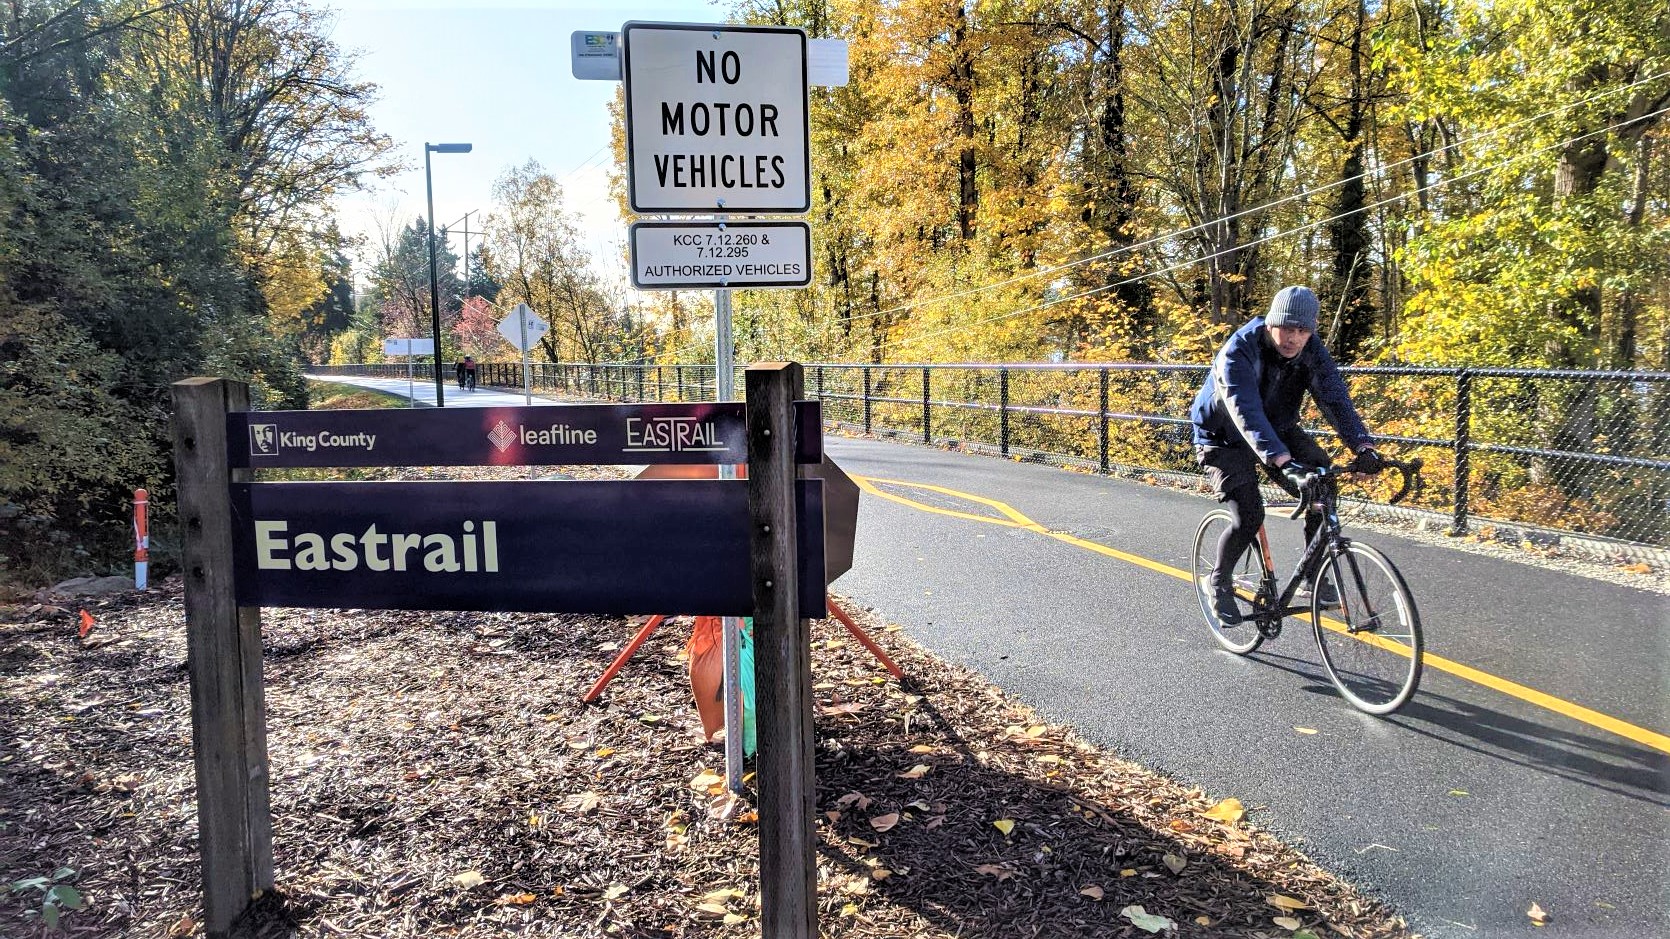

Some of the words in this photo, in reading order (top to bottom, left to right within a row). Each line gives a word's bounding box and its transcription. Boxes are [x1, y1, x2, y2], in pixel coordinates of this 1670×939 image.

[696, 50, 741, 85] NO
[661, 102, 779, 136] MOTOR
[653, 154, 785, 188] VEHICLES
[673, 235, 703, 246] KCC
[706, 234, 758, 246] 7.12.260
[761, 234, 770, 245] &
[697, 246, 749, 258] 7.12.295
[644, 264, 733, 277] AUTHORIZED
[735, 263, 801, 276] VEHICLES
[280, 431, 317, 452] King
[318, 430, 376, 451] County
[519, 424, 598, 445] leafline
[626, 417, 724, 451] EASTRAIL
[254, 520, 499, 573] Eastrail
